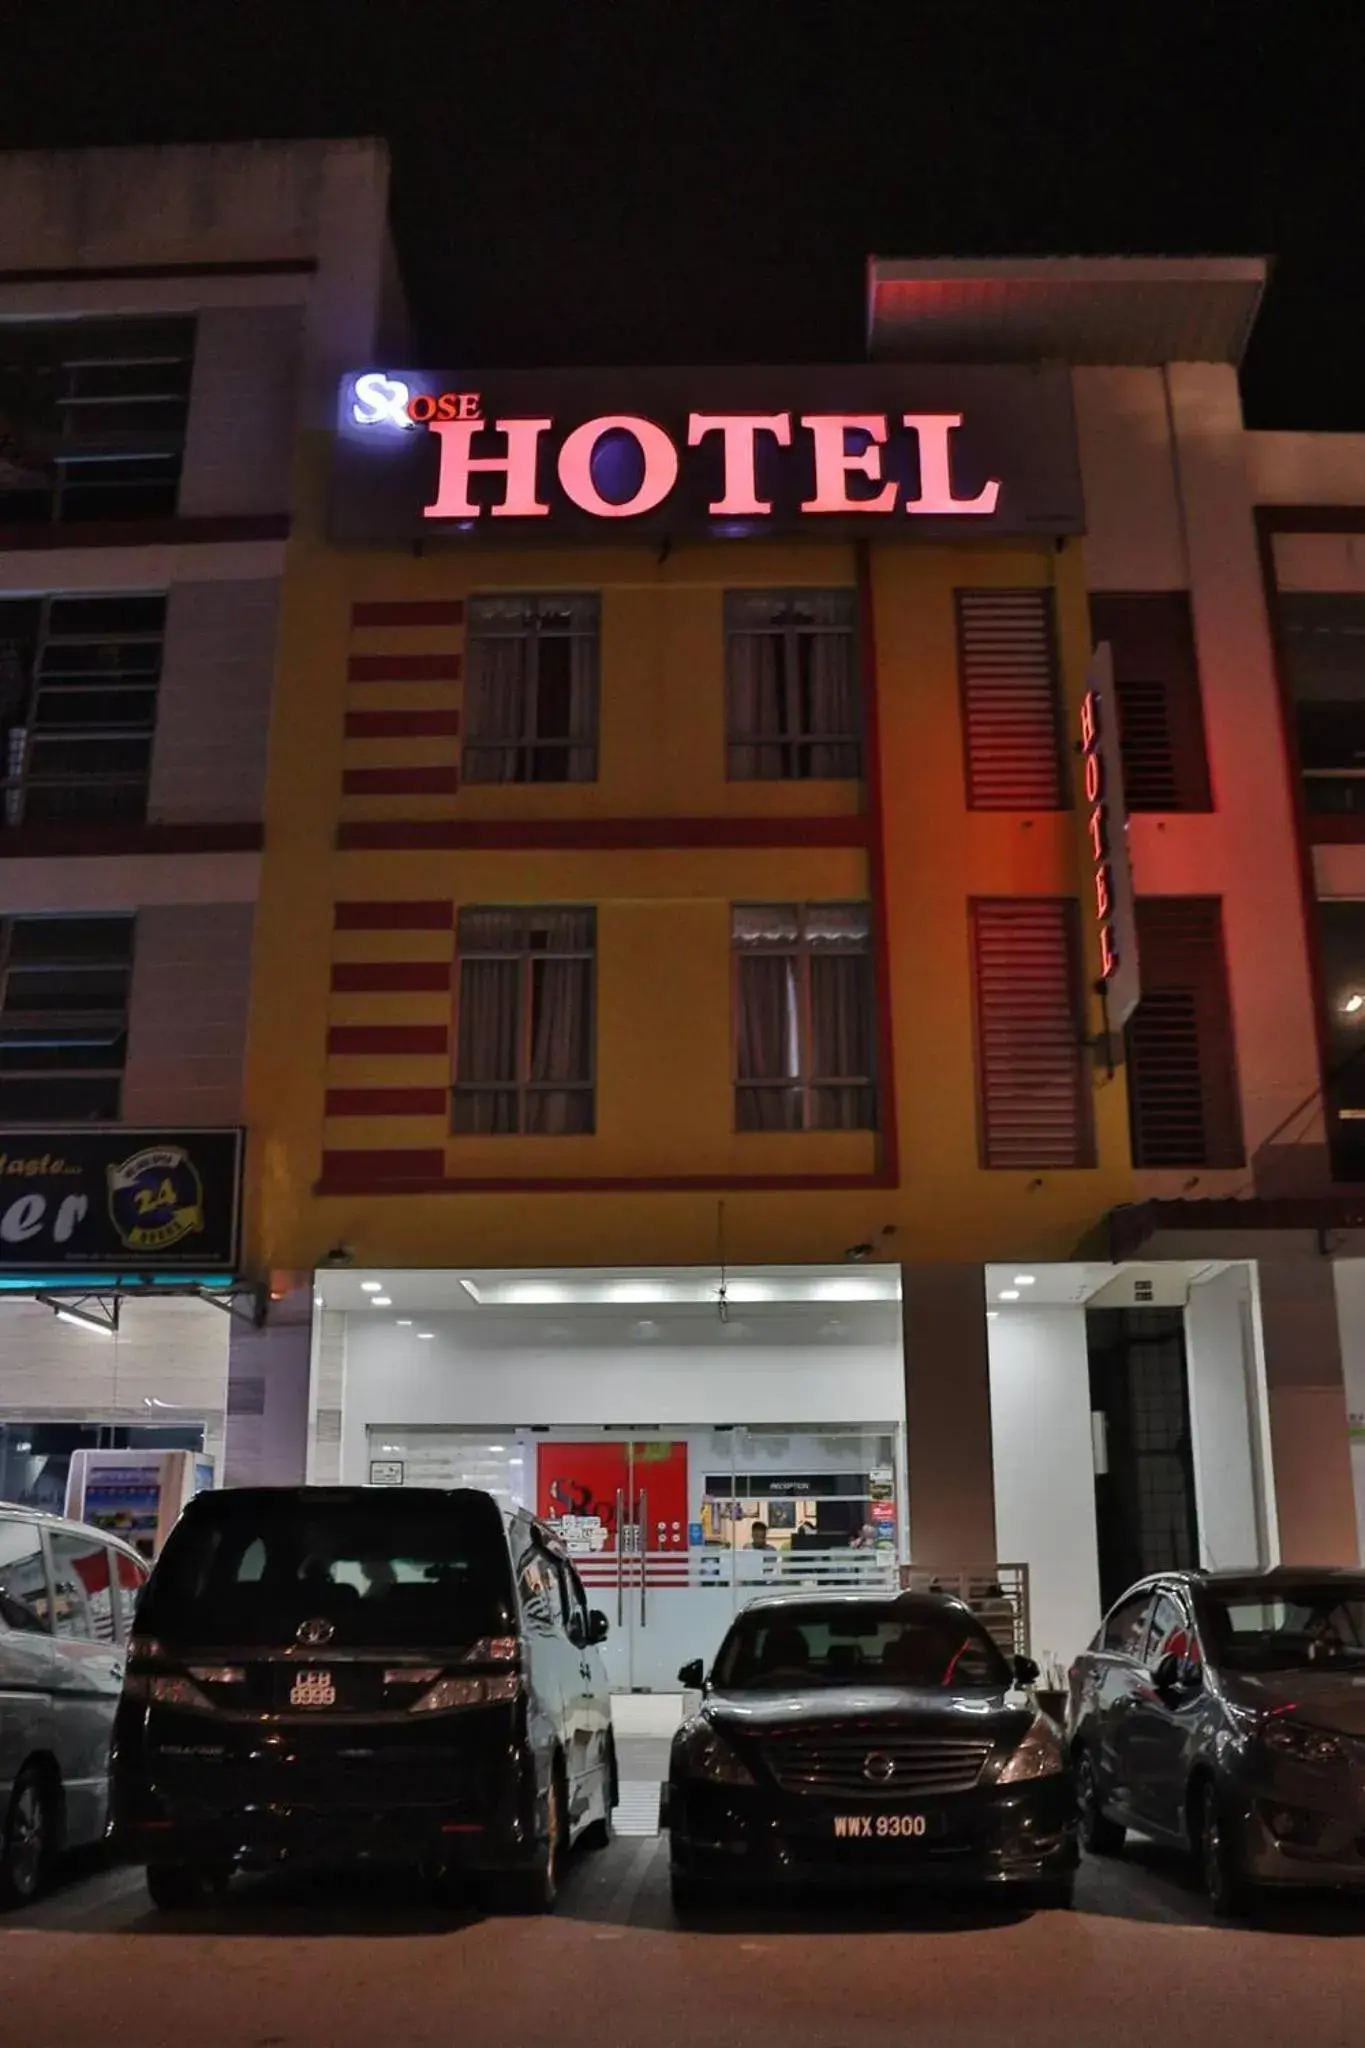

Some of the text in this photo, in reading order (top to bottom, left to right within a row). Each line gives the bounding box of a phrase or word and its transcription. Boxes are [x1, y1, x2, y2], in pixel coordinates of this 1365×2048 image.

[424, 412, 1000, 518] HOTEL
[1080, 689, 1116, 978] HOTEL
[133, 1177, 177, 1215] 24
[833, 1815, 926, 1837] WWX 9300
